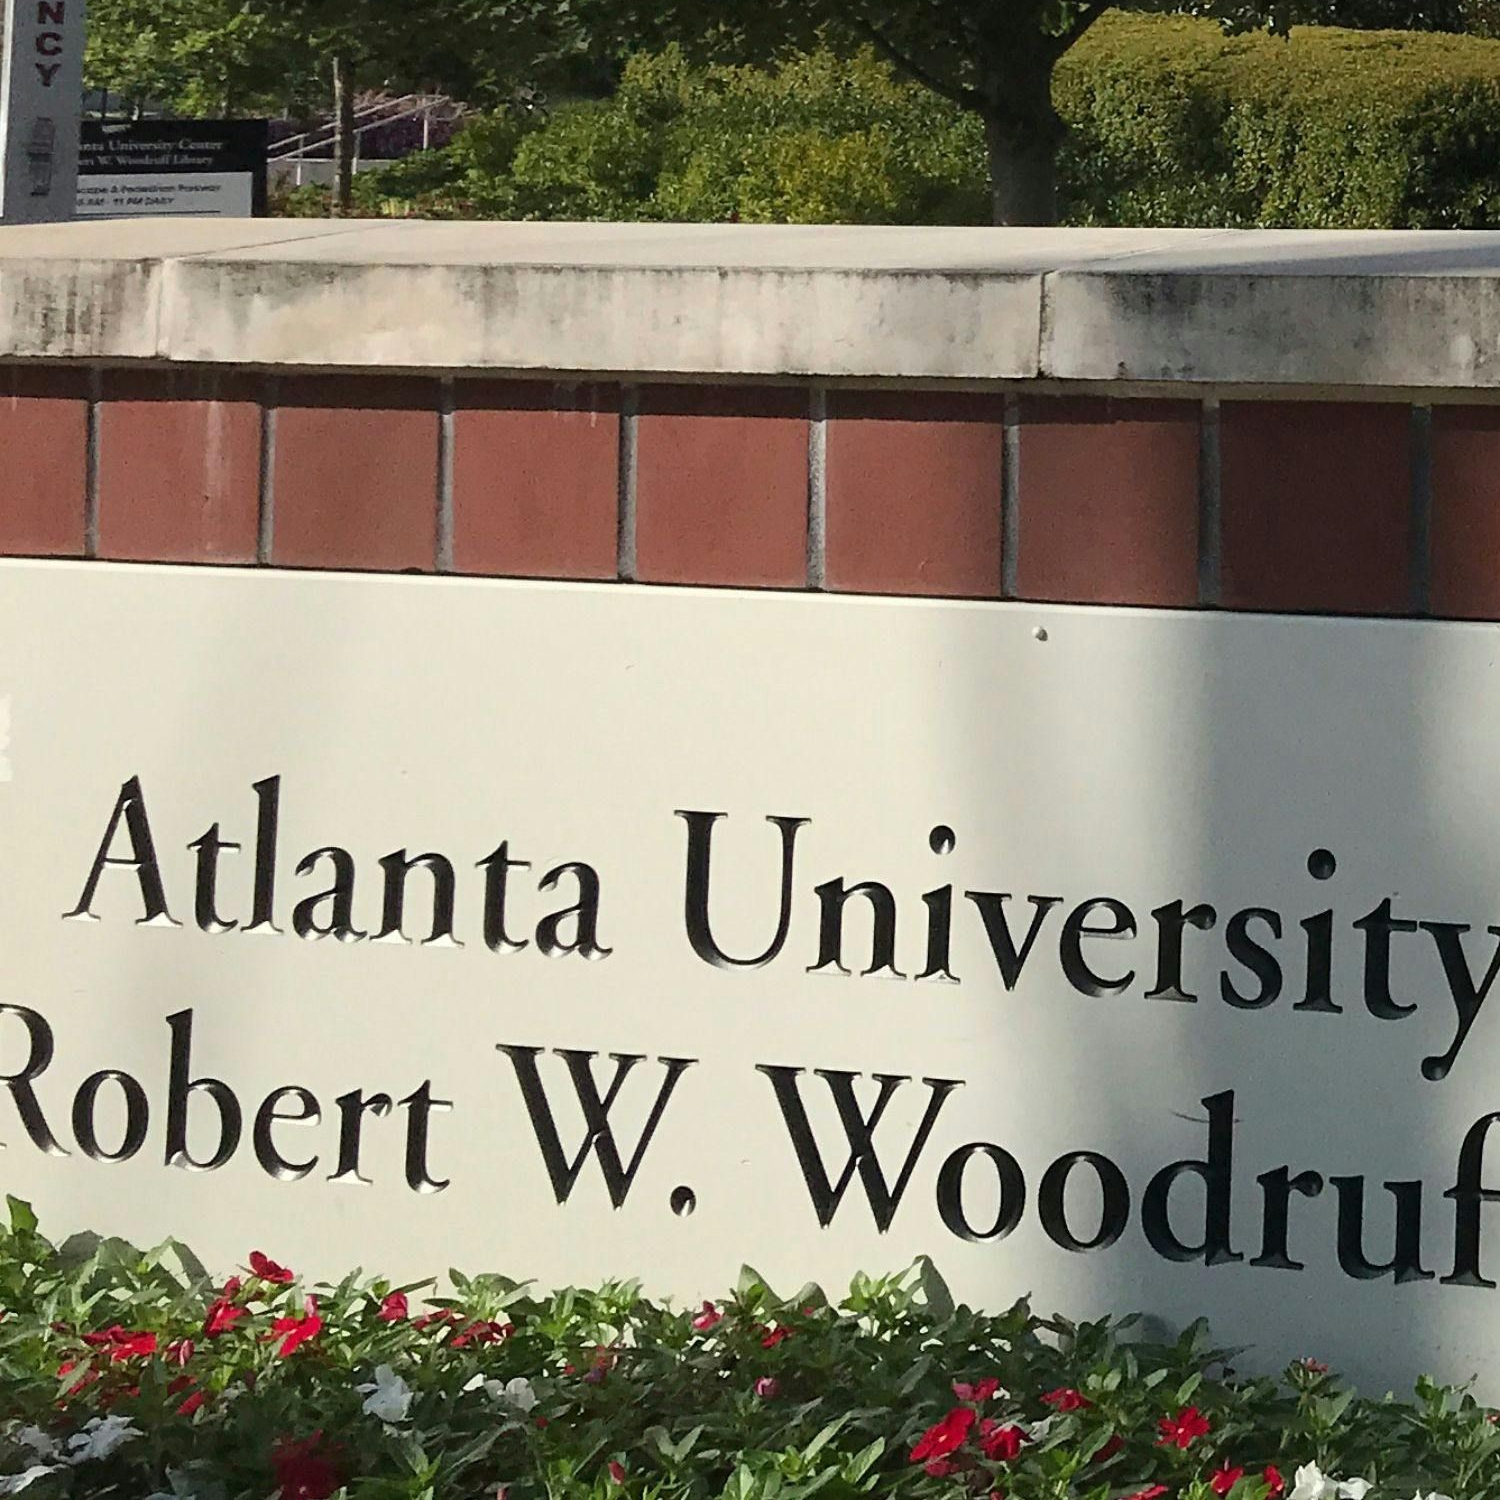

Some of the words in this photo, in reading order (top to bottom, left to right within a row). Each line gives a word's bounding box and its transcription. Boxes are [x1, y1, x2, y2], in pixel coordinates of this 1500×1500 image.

[108, 139, 176, 153] University
[178, 137, 223, 150] Center
[115, 154, 171, 165] Woodruff
[173, 154, 214, 167] Library
[62, 774, 613, 962] Atlanta
[495, 1043, 699, 1218] W.
